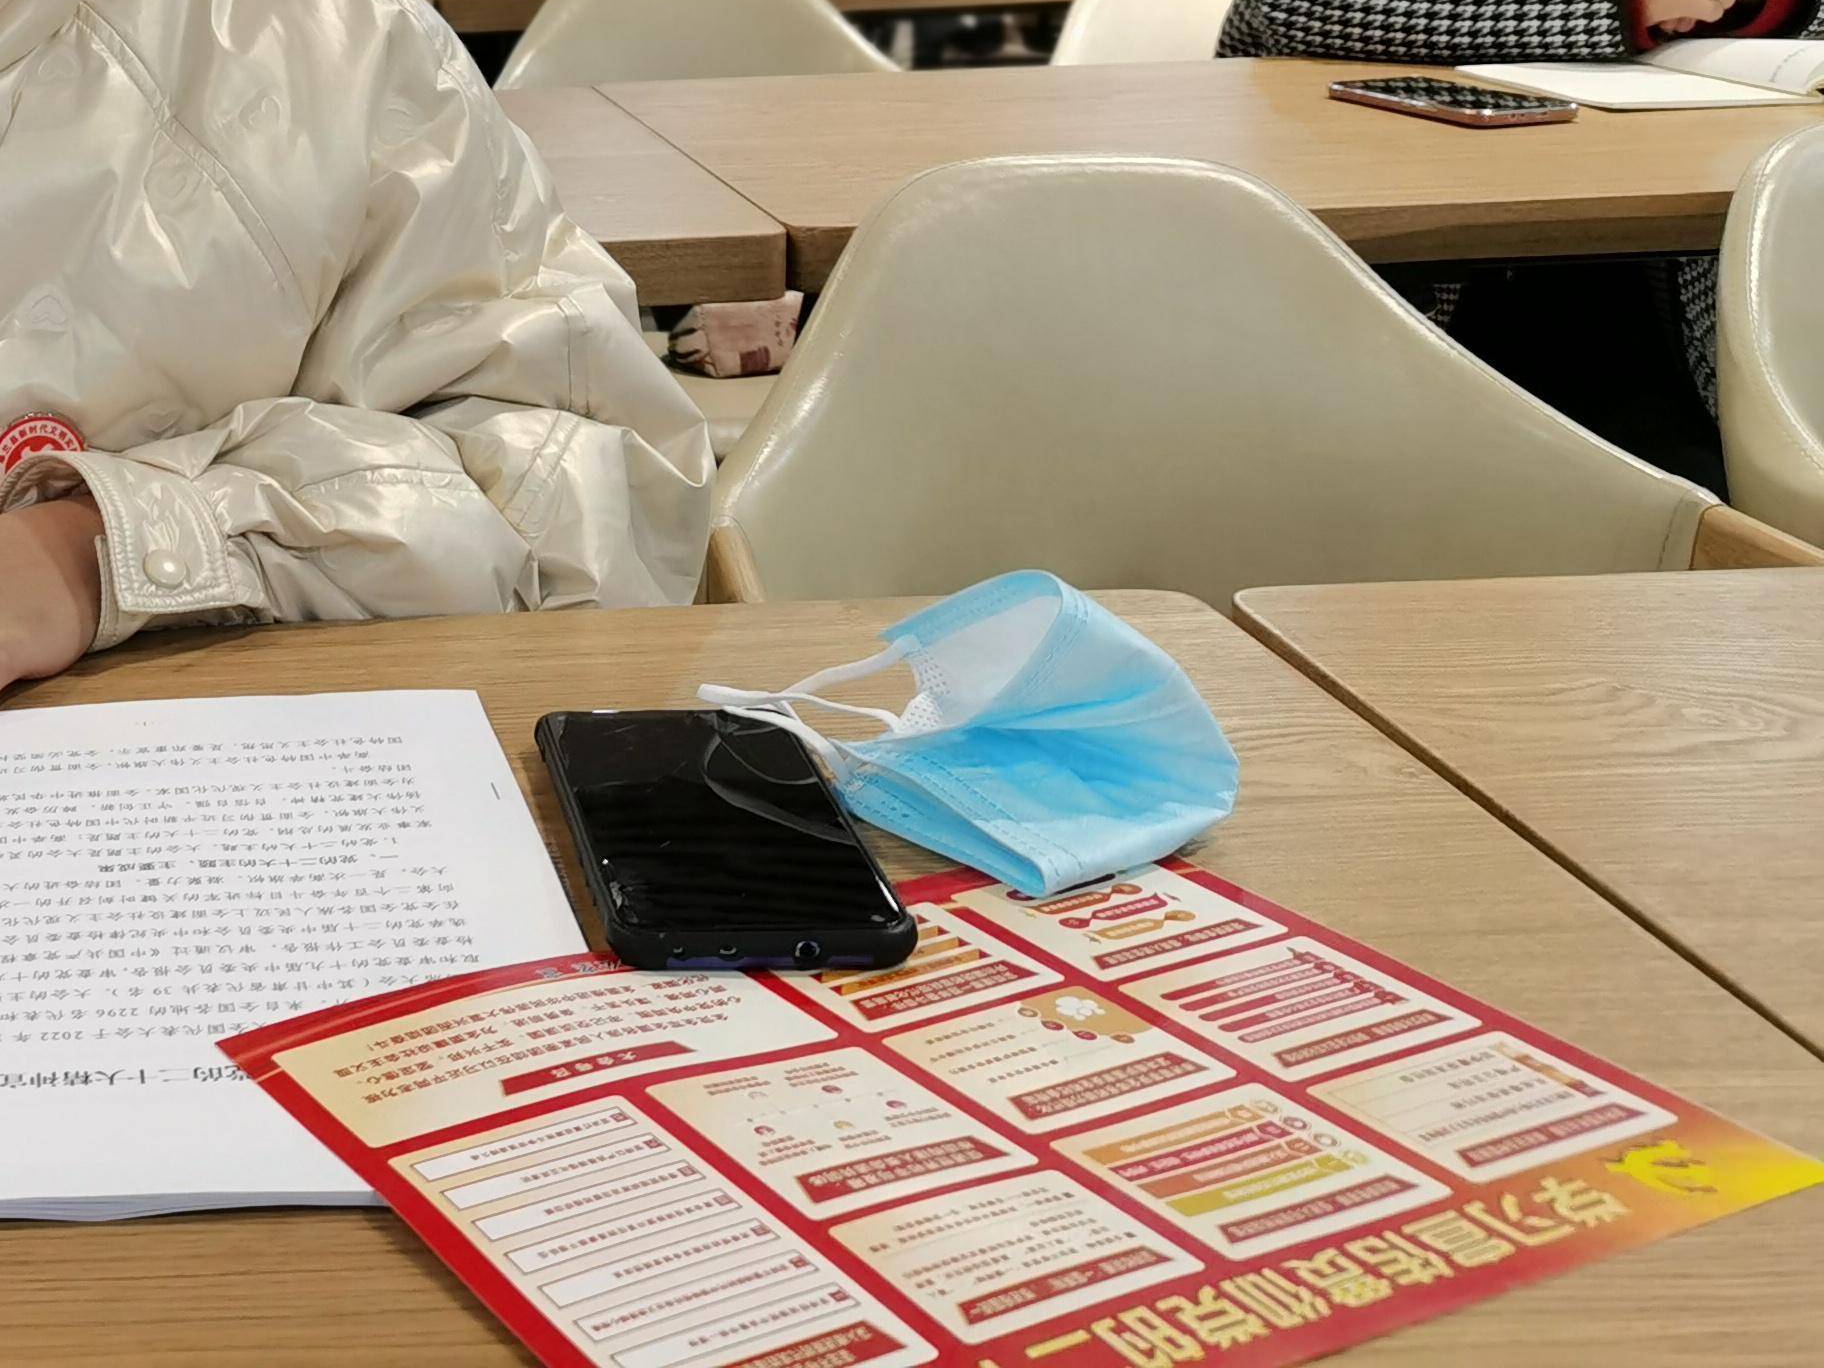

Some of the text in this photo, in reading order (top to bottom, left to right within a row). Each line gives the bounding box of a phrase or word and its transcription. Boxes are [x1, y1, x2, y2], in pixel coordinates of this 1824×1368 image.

[976, 1175, 1632, 1367] 学习宣传贯彻党的
